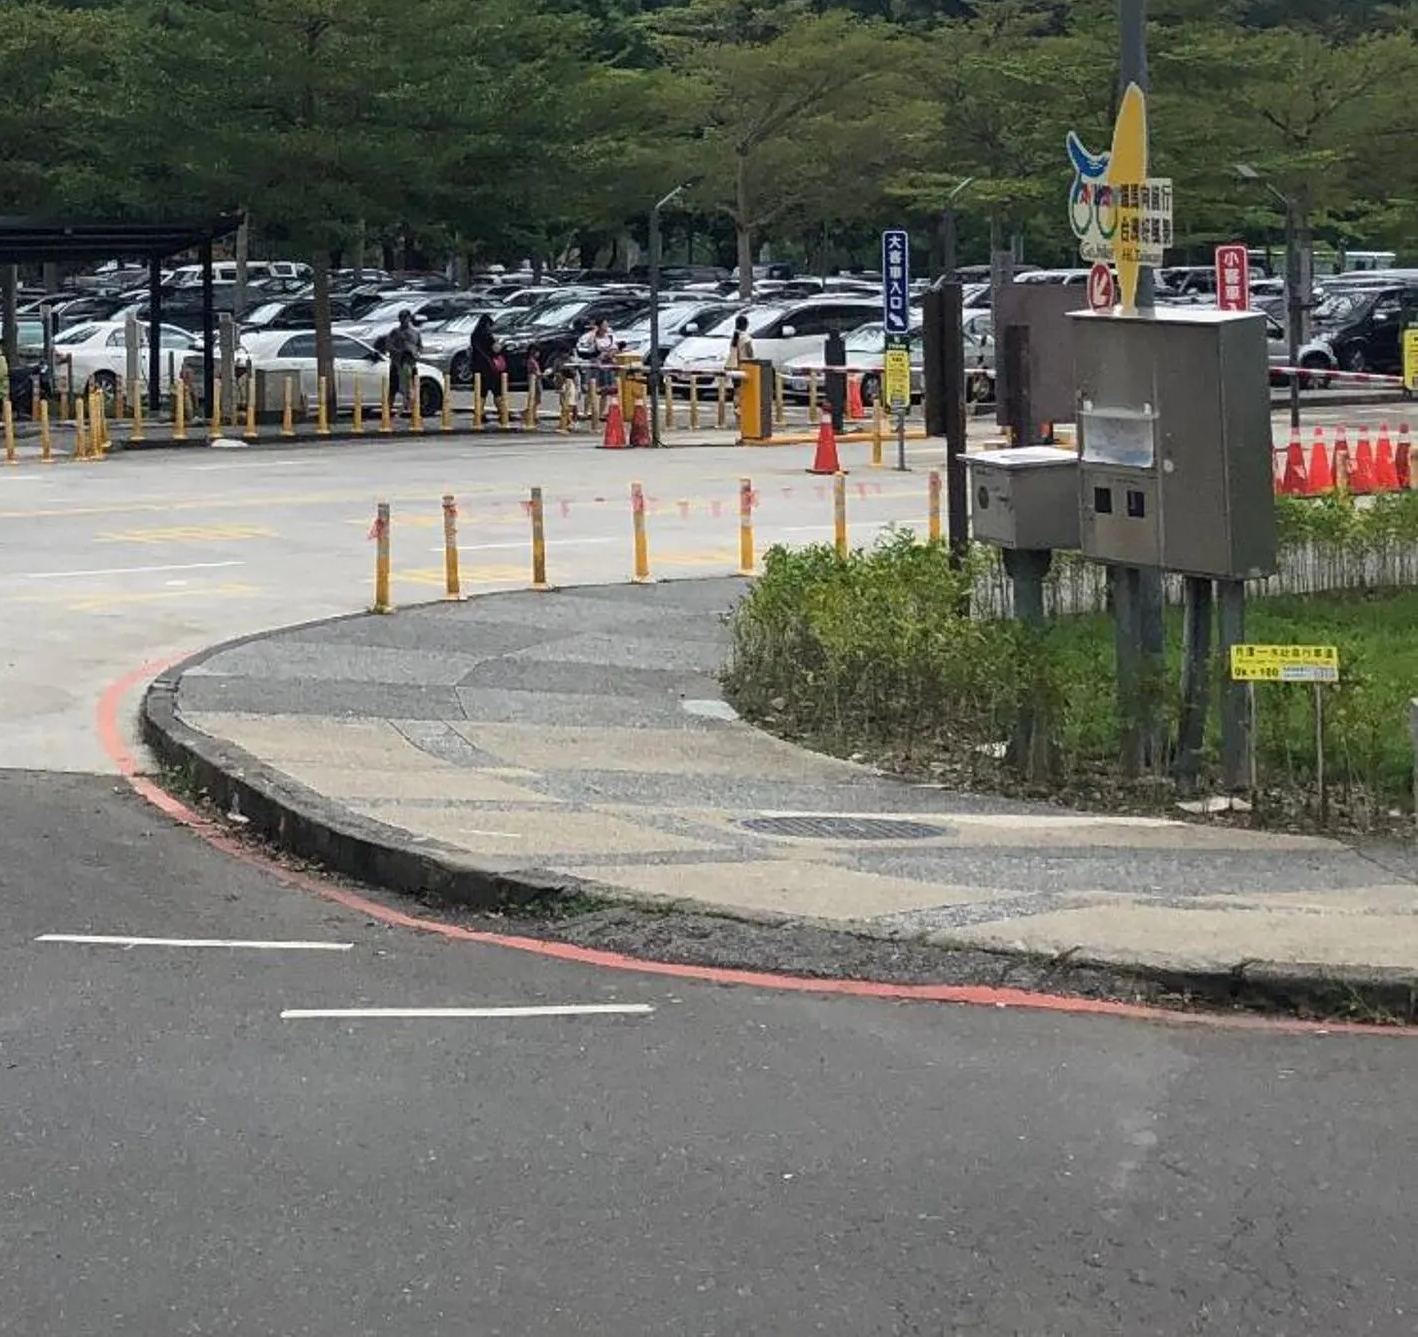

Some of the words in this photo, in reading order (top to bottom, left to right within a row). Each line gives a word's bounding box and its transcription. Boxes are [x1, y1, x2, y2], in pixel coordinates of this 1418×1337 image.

[888, 234, 903, 310] 大客車入口
